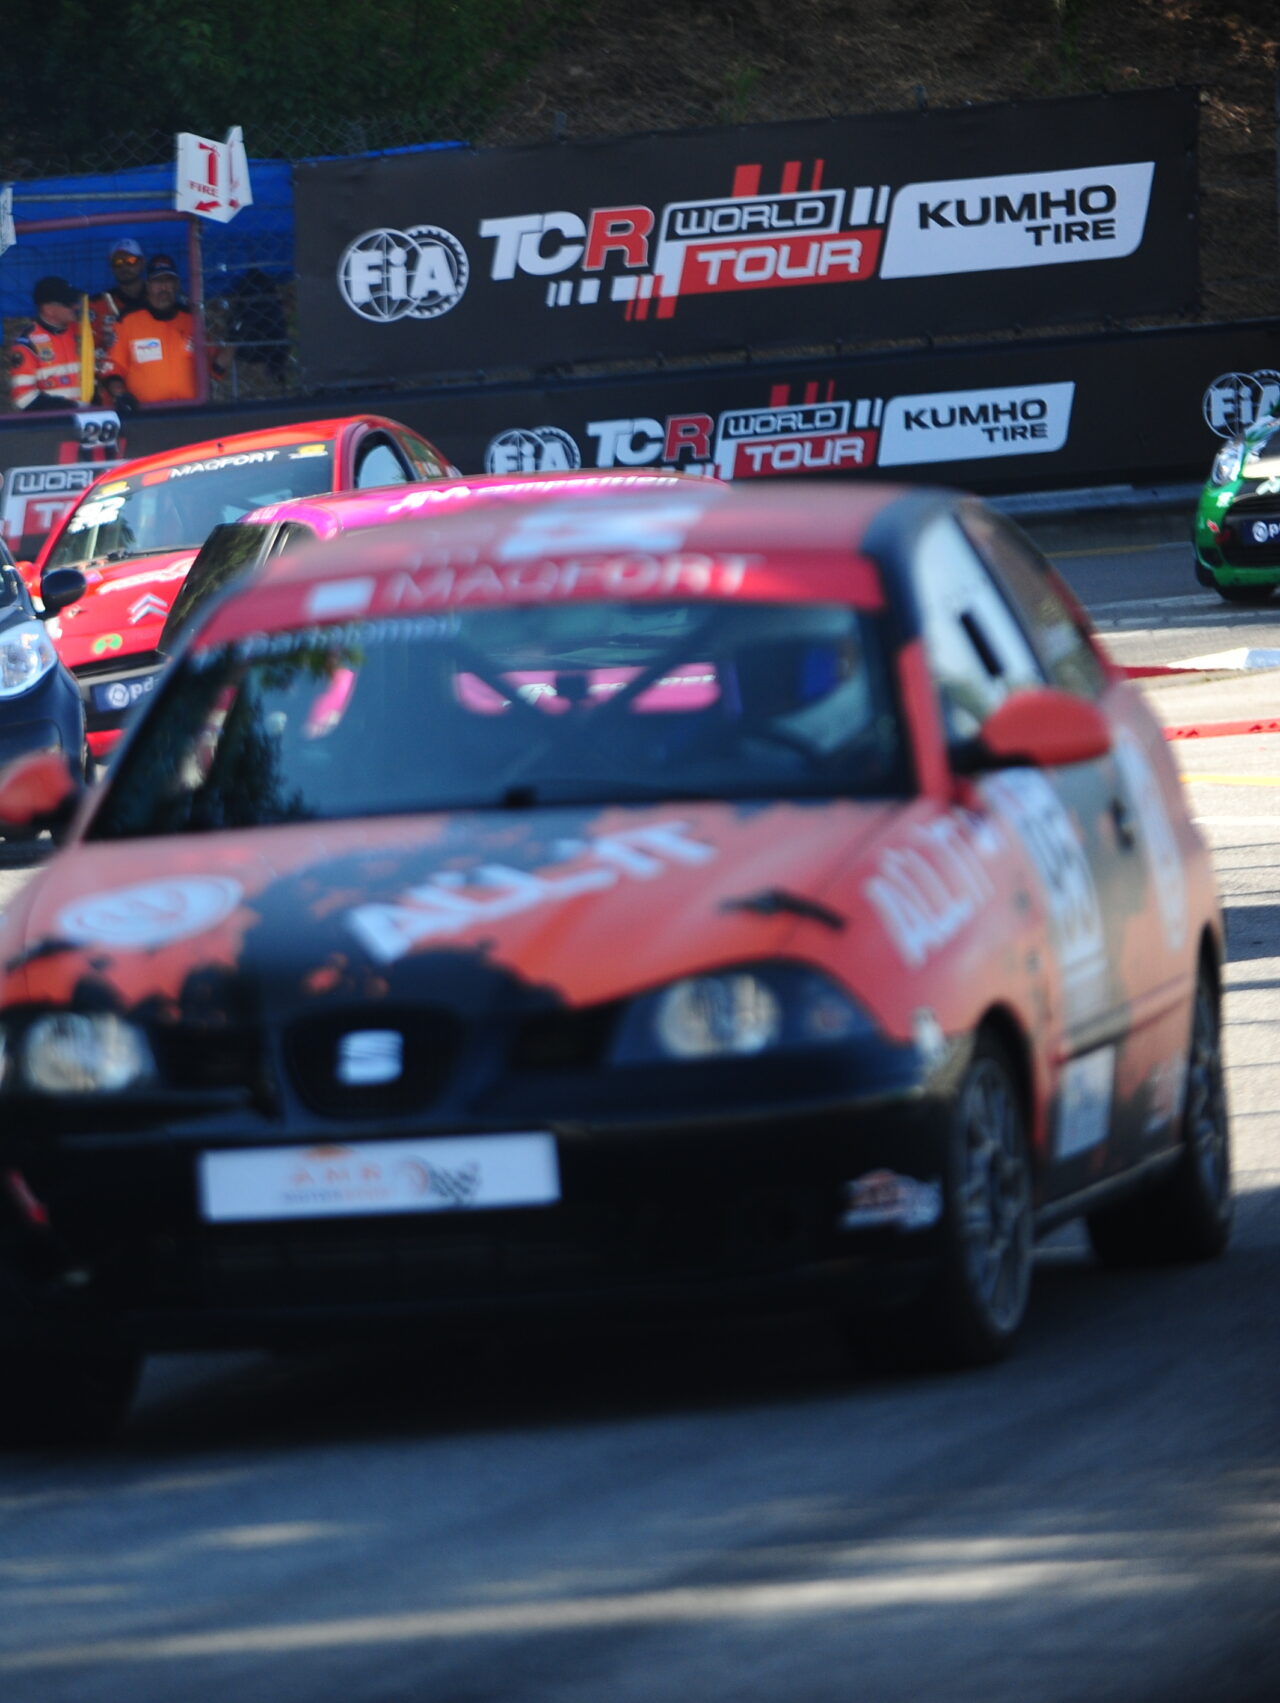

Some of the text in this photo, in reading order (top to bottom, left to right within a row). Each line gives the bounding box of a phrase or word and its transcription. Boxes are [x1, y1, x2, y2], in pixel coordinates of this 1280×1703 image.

[674, 200, 826, 237] WORLD
[918, 184, 1117, 230] KUMHO
[477, 203, 656, 281] TCR
[1024, 217, 1116, 247] TIRE
[696, 238, 864, 286] TOUR
[727, 405, 837, 436] WORLD
[903, 398, 1048, 432] KUMHO
[981, 422, 1049, 444] TIRE
[586, 412, 715, 468] TCR
[743, 436, 866, 472] TOUR
